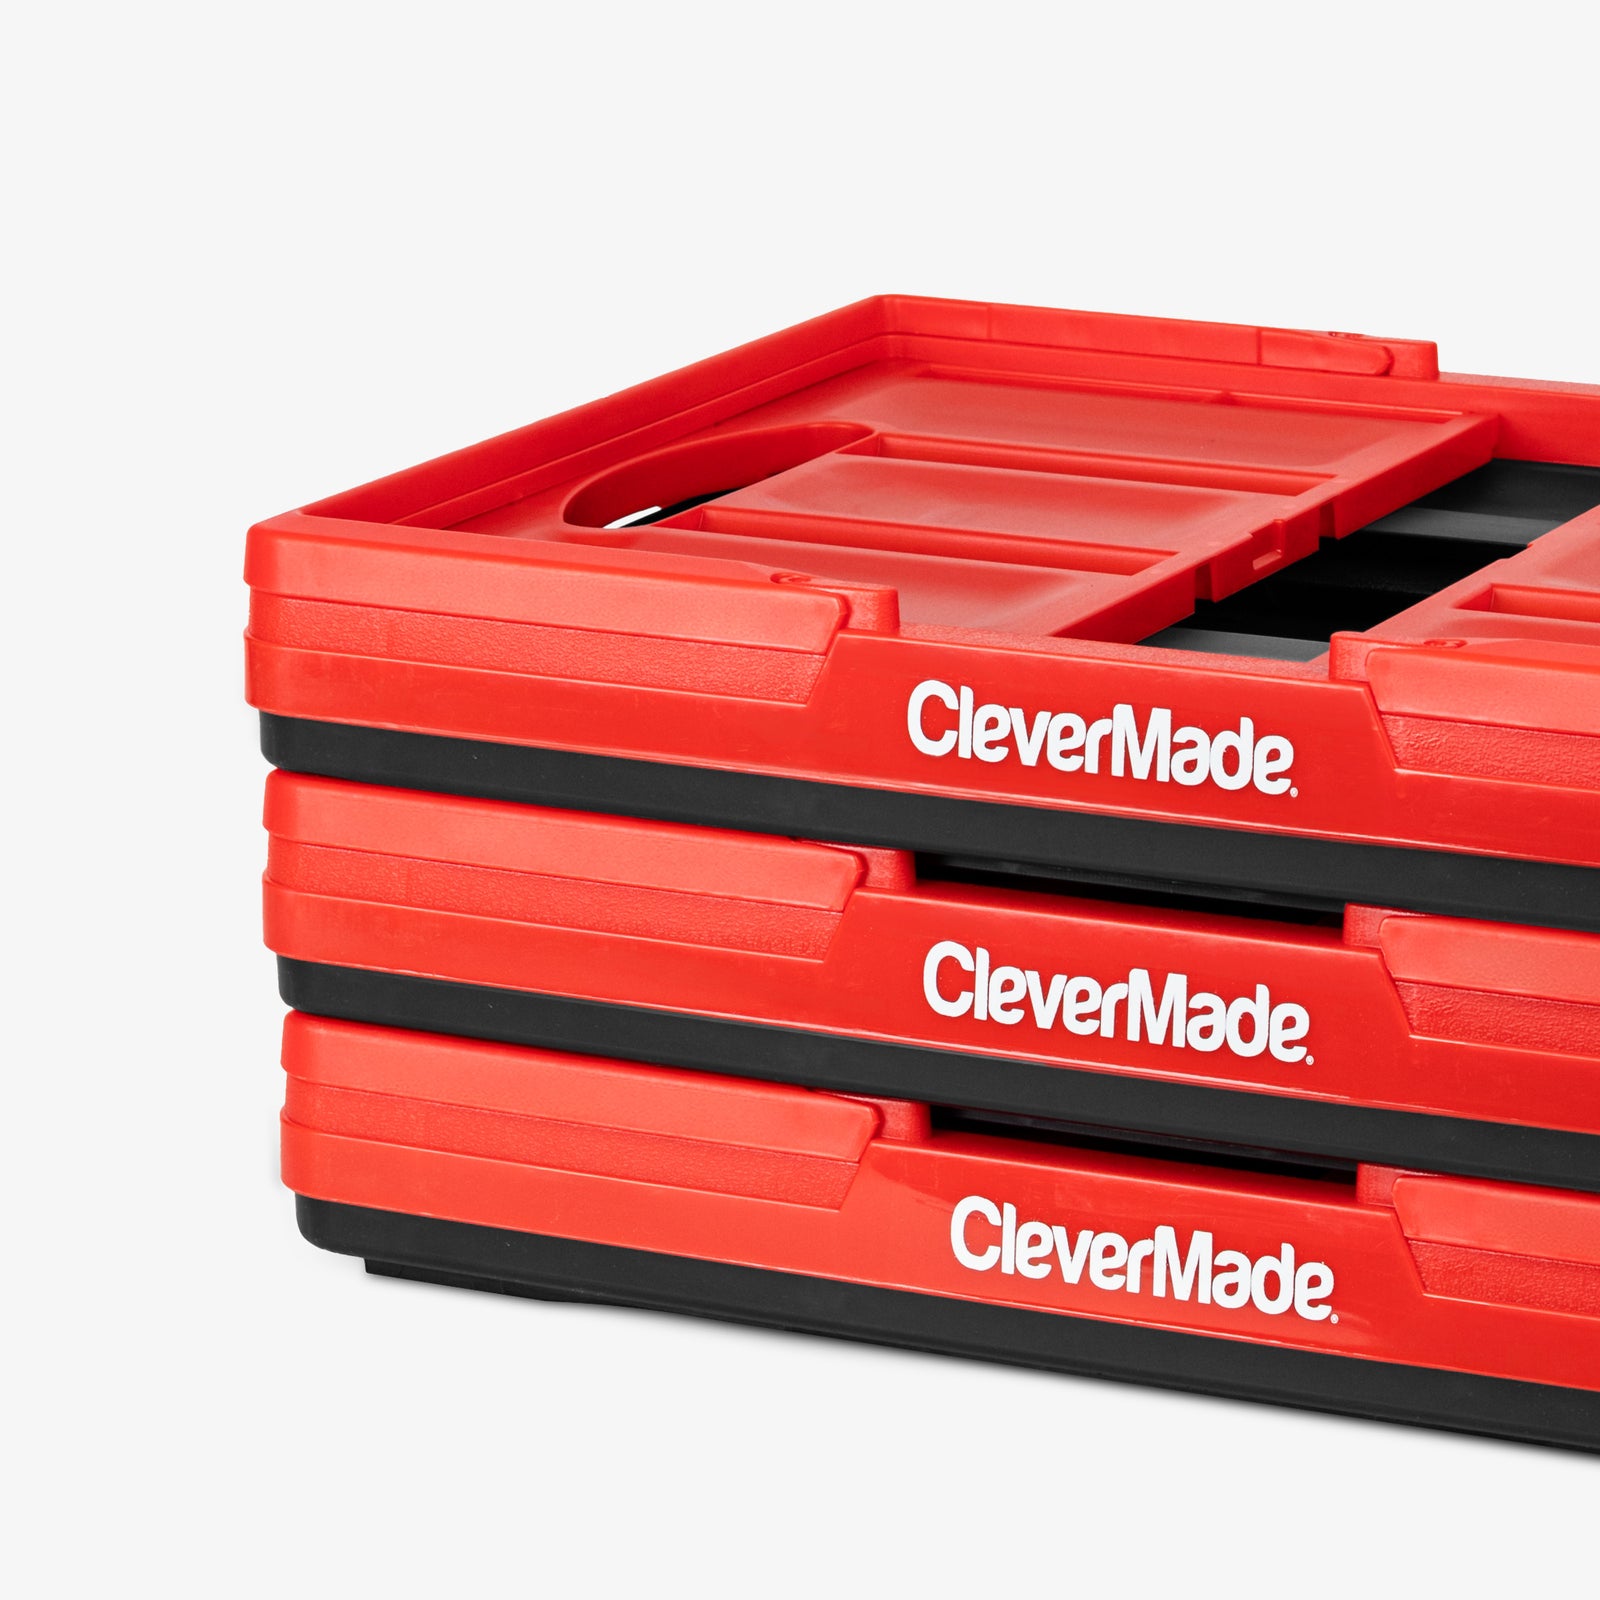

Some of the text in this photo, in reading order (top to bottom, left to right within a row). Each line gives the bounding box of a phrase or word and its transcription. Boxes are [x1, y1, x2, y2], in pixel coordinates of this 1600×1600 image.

[908, 680, 1294, 796] CleverMade
[923, 941, 1310, 1063] CleverMade
[950, 1196, 1335, 1322] CleverMade
